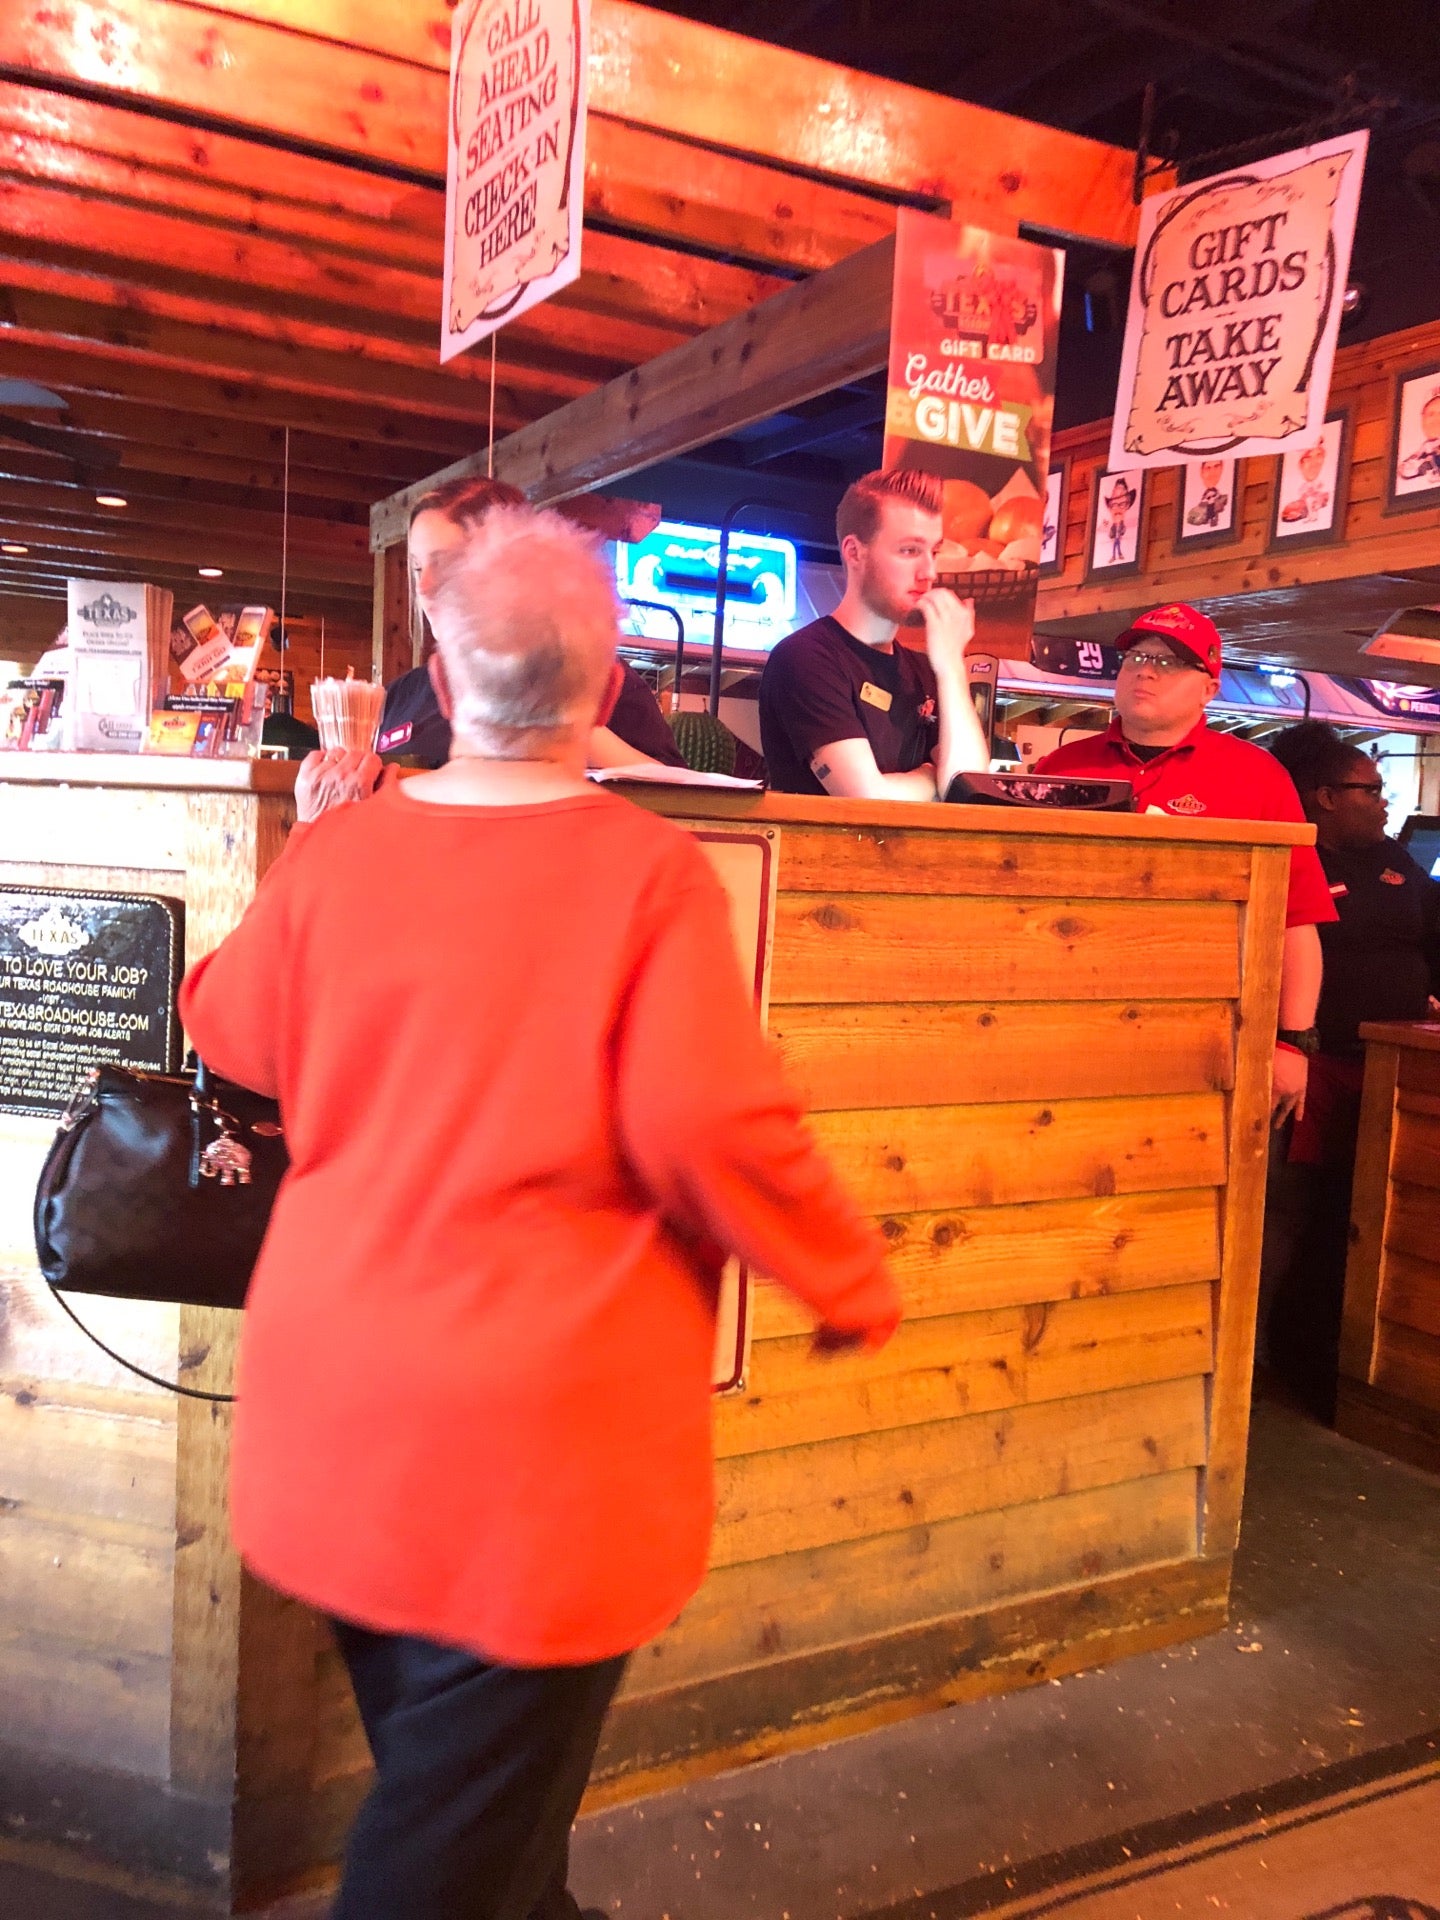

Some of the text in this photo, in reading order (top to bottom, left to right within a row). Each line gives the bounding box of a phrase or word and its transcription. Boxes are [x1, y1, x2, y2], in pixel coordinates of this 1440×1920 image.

[487, 0, 540, 57] CALL
[477, 28, 549, 115] AHEAD
[467, 61, 558, 179] SEATING
[465, 120, 560, 237] CHECK IN
[479, 178, 538, 269] HERE!
[1188, 210, 1288, 270] GIFT
[944, 291, 1026, 320] TEXS
[1160, 250, 1308, 318] CARDS
[940, 338, 1035, 363] GIFT CARD
[1166, 313, 1282, 370] TAKE
[905, 352, 994, 401] Gather
[1154, 356, 1282, 412] AWAY
[915, 396, 1021, 456] GIVE
[88, 606, 129, 621] TEXAS
[3, 955, 148, 985] TO LOVE YOUR JOB?
[13, 977, 40, 992] TEXAS
[43, 980, 100, 997] ROADHOUSE
[102, 985, 136, 1000] FAMILY!
